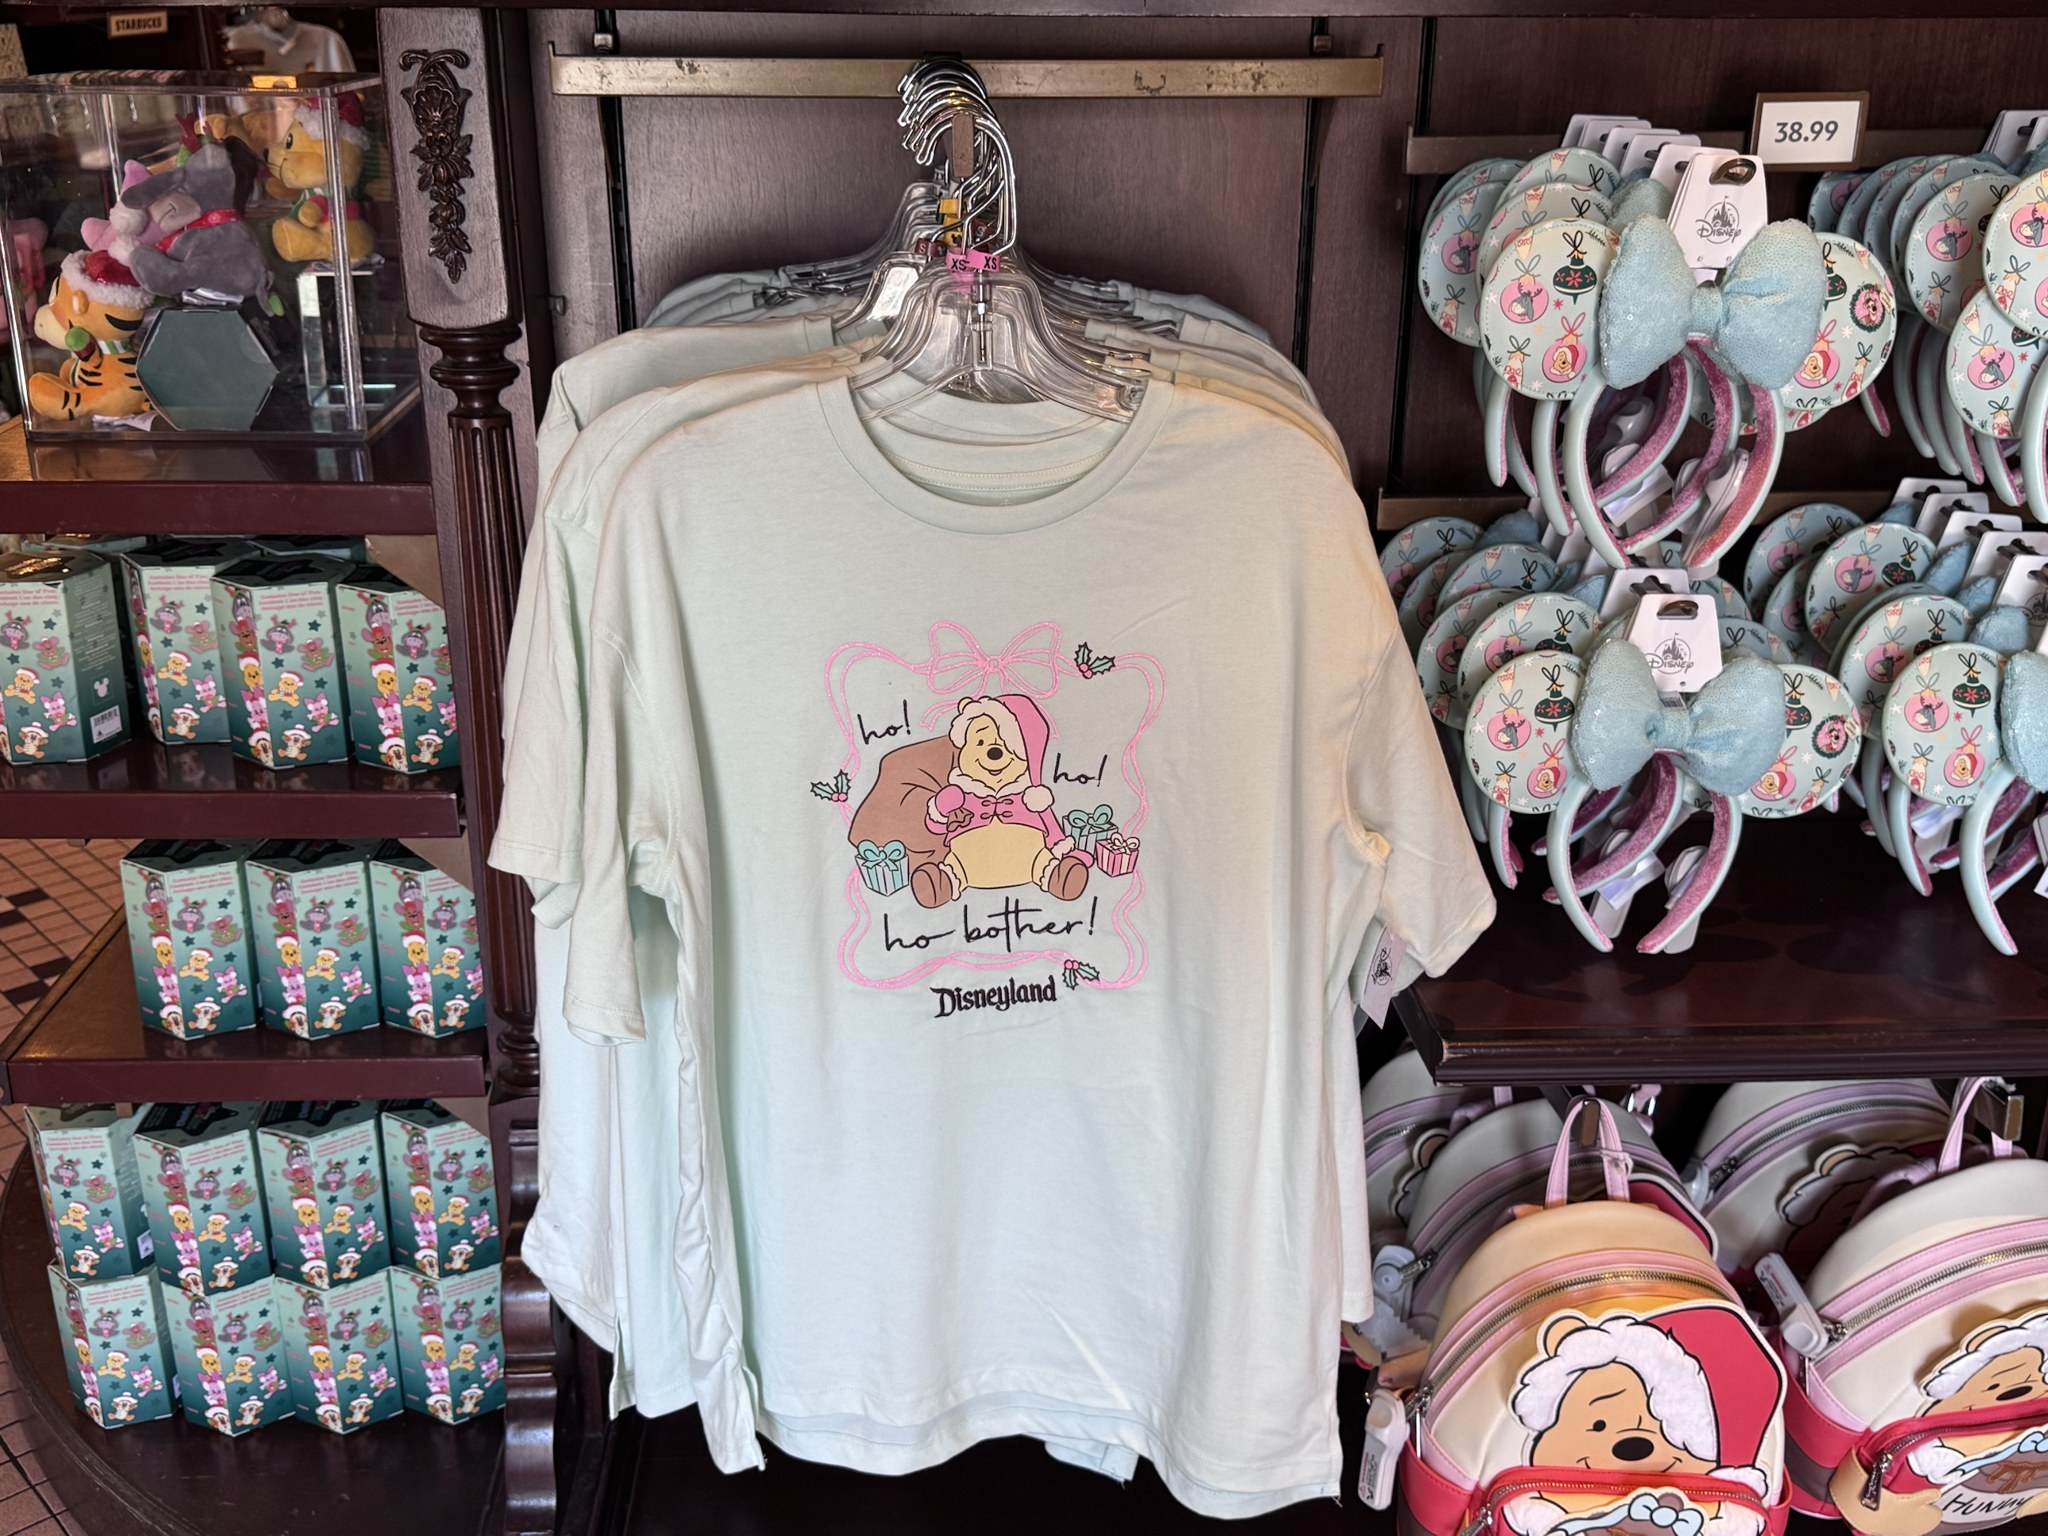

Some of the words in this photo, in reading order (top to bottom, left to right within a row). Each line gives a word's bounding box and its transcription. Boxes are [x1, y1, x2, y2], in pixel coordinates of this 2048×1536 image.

[115, 17, 162, 32] STARBUCKS
[1774, 120, 1839, 143] 38.99
[951, 258, 969, 271] XS
[984, 256, 997, 270] XS
[857, 699, 912, 745] ho!
[1053, 752, 1108, 788] ho!
[930, 975, 1058, 1018] Disneyland
